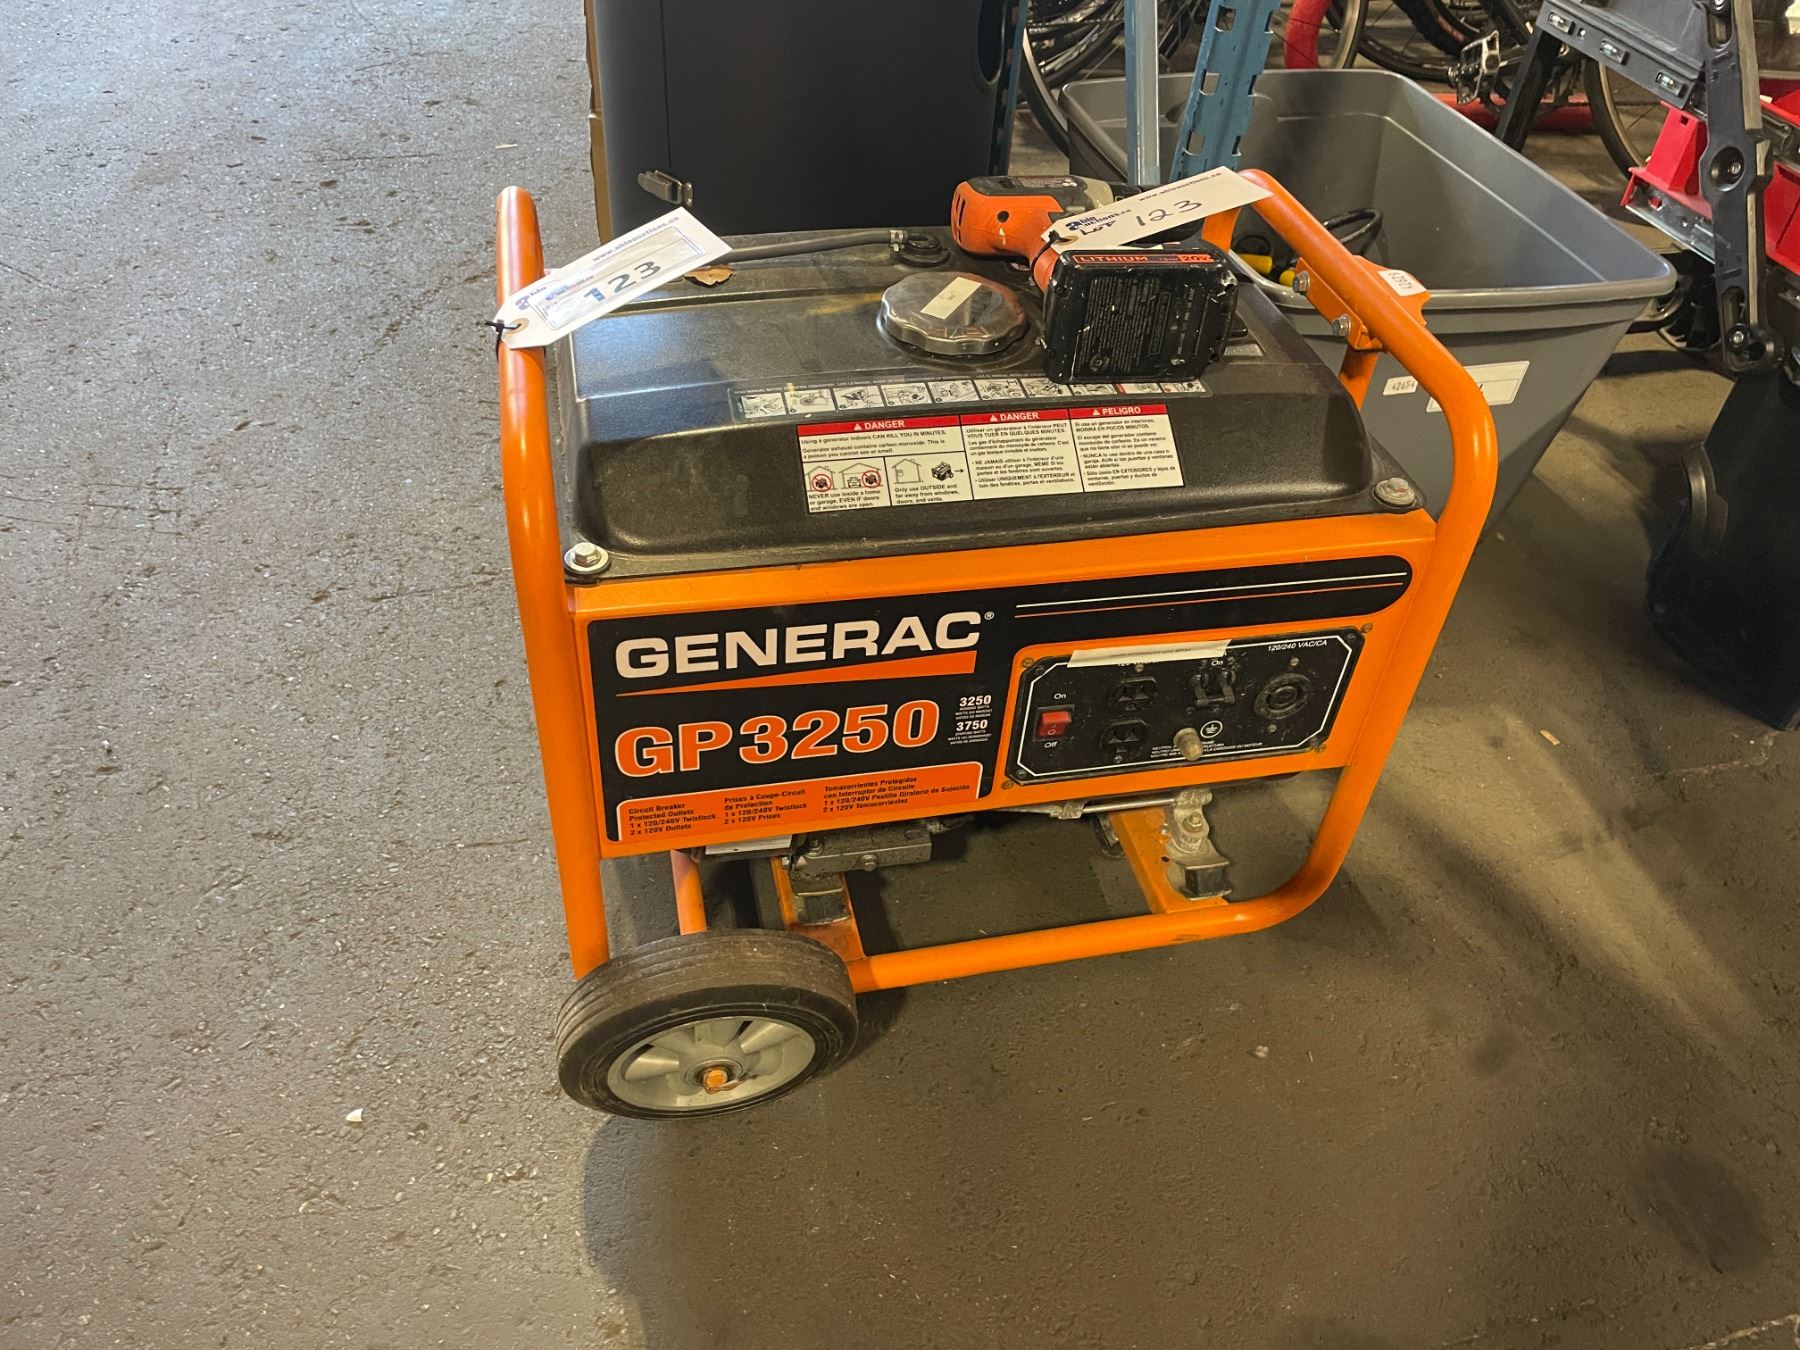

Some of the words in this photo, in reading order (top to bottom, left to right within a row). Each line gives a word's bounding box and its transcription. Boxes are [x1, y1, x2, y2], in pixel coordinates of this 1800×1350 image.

[1136, 200, 1202, 226] 123
[584, 261, 661, 302] 123
[1102, 406, 1142, 415] PELIGRO
[1000, 412, 1040, 421] DANGER
[864, 420, 905, 430] DANGER
[1268, 643, 1297, 651] 120/240
[1298, 640, 1327, 648] VAC/CA
[1211, 659, 1224, 667] On
[959, 695, 992, 707] 3250
[956, 719, 988, 731] 3750
[615, 700, 940, 778] GP3250
[825, 782, 878, 791] Tomacorrientes
[880, 777, 917, 786] Protegidos
[756, 789, 805, 799] Coupe-Circuit
[837, 796, 870, 804] 120/240V
[900, 789, 929, 797] Giratorio
[941, 784, 970, 792] Sujeción
[838, 789, 875, 797] Interruptor
[628, 806, 654, 814] Circuit
[656, 803, 685, 811] Breaker
[736, 801, 772, 809] Protection
[738, 807, 773, 815] 120/240V
[775, 803, 807, 811] Twistlock
[856, 798, 908, 809] Tomacorrientes
[629, 812, 666, 821] Protected
[644, 819, 680, 827] 120/240V
[682, 813, 716, 822] Twistlock
[738, 815, 756, 823] 120V
